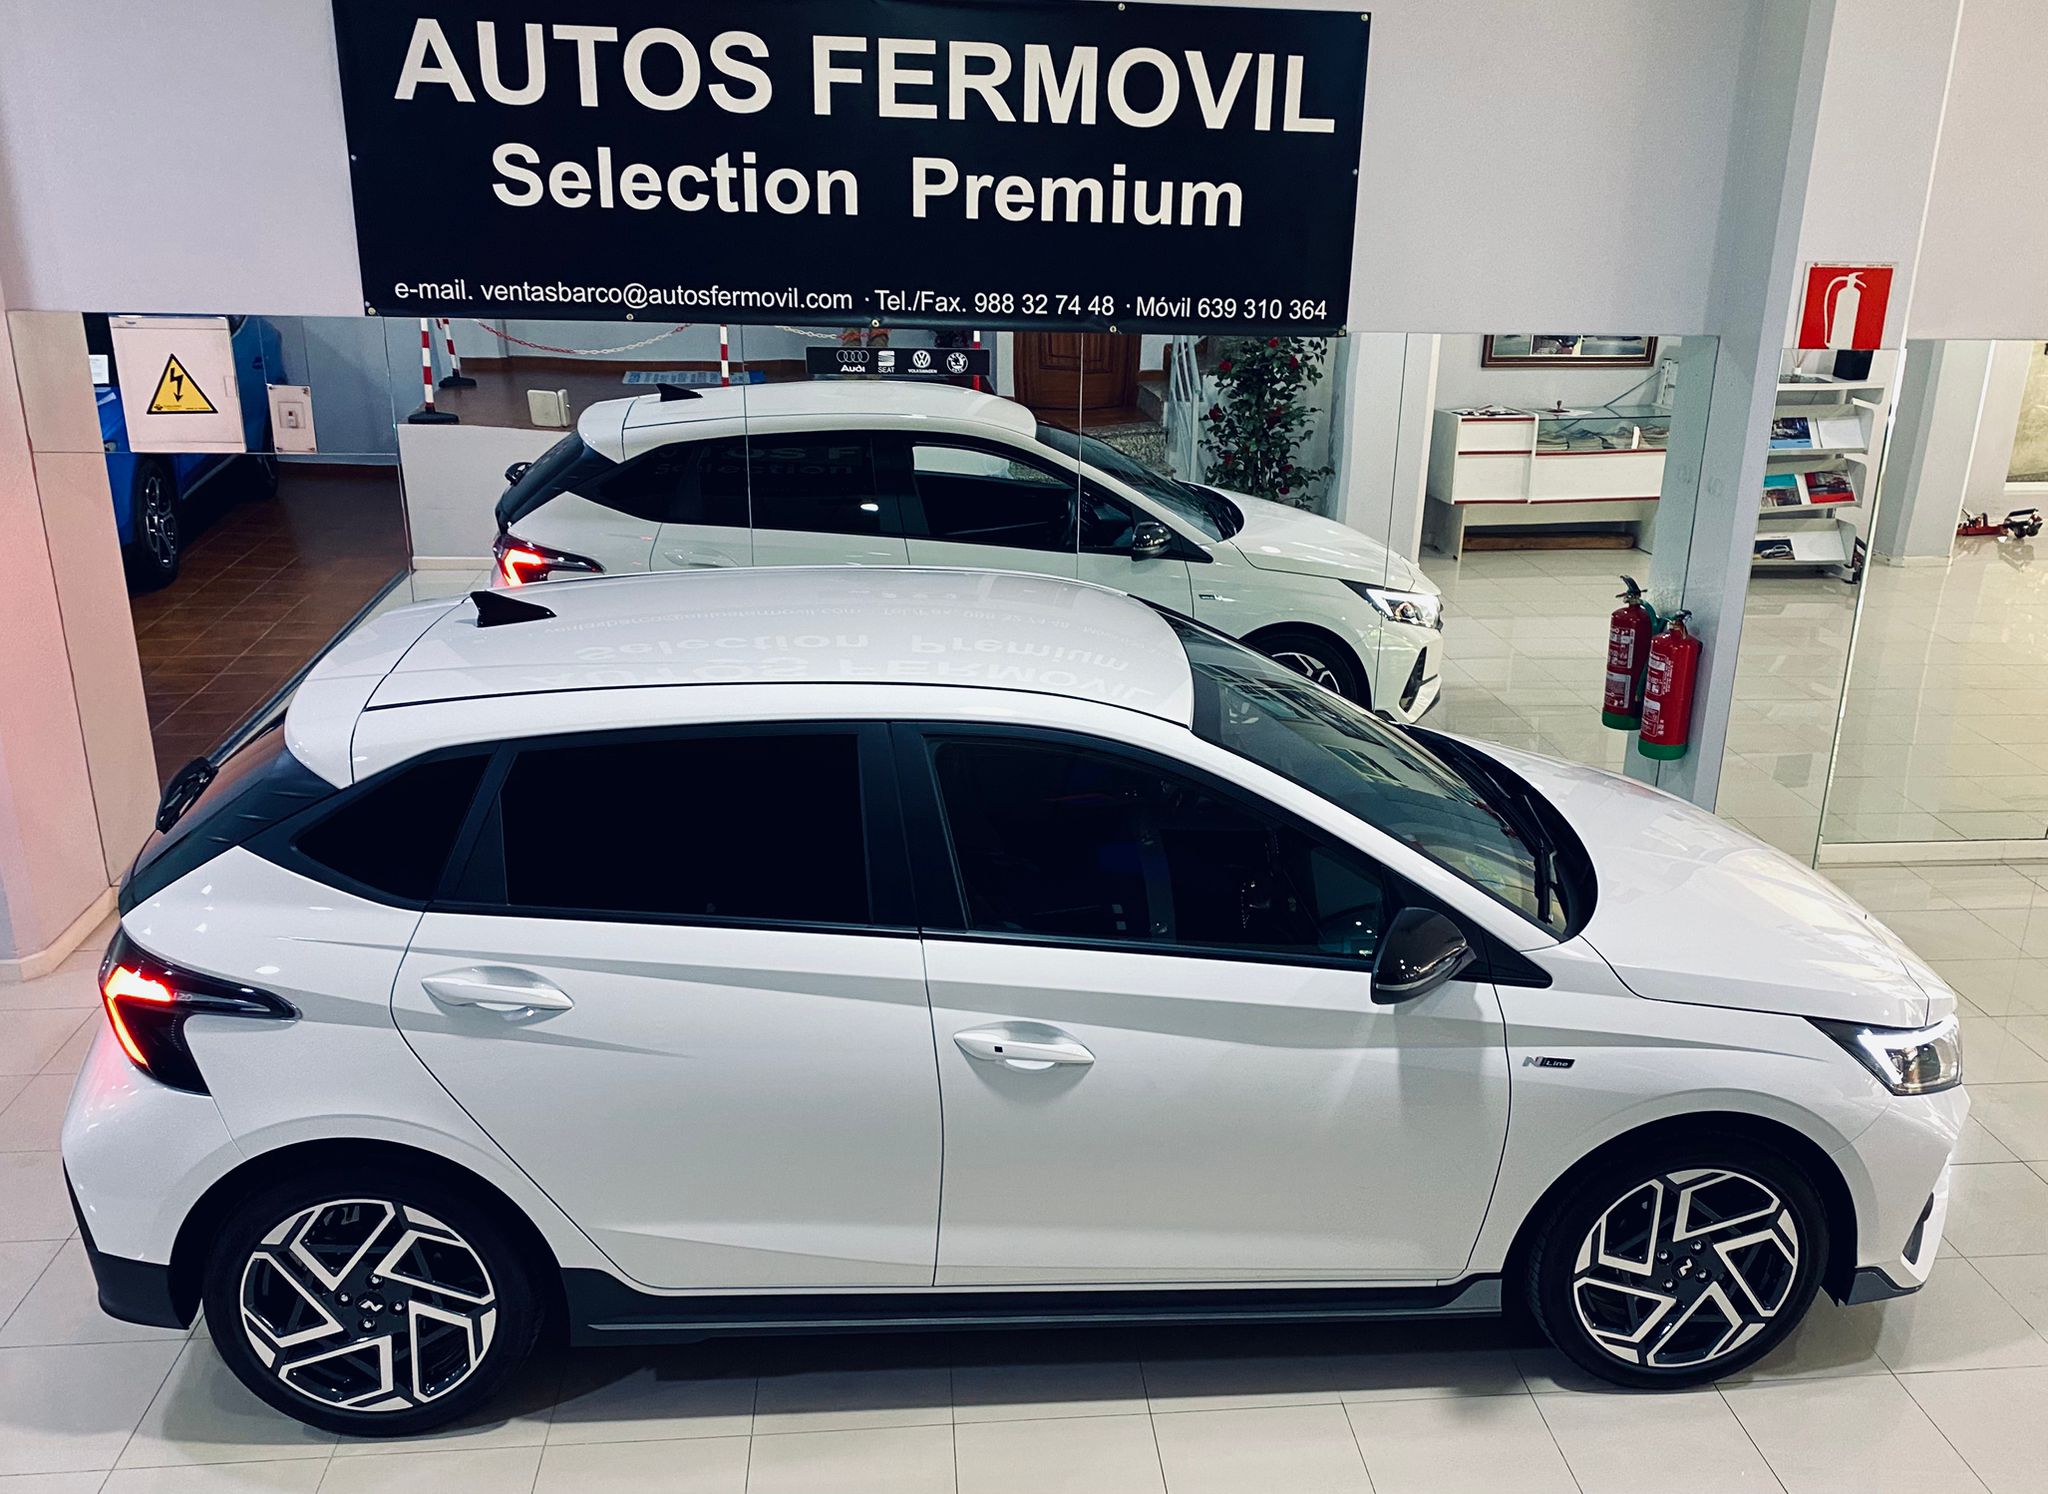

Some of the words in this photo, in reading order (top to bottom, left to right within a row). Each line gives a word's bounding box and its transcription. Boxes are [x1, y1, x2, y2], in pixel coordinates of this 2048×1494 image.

[395, 18, 772, 113] AUTOS
[813, 35, 1335, 133] FERMOVIL
[493, 143, 858, 215] Selection
[913, 157, 1242, 226] Premium
[395, 279, 473, 300] e-mail.
[481, 282, 852, 310] ventasbarco@autosfermovil.com
[975, 292, 1014, 313] 988
[1022, 293, 1047, 314] 32
[1056, 294, 1081, 315] 74
[1088, 295, 1114, 316] 48
[1137, 296, 1190, 317] Móvil
[1198, 297, 1236, 318] 639
[1244, 298, 1282, 319] 310
[1289, 299, 1327, 320] 364
[840, 364, 866, 373] Audi
